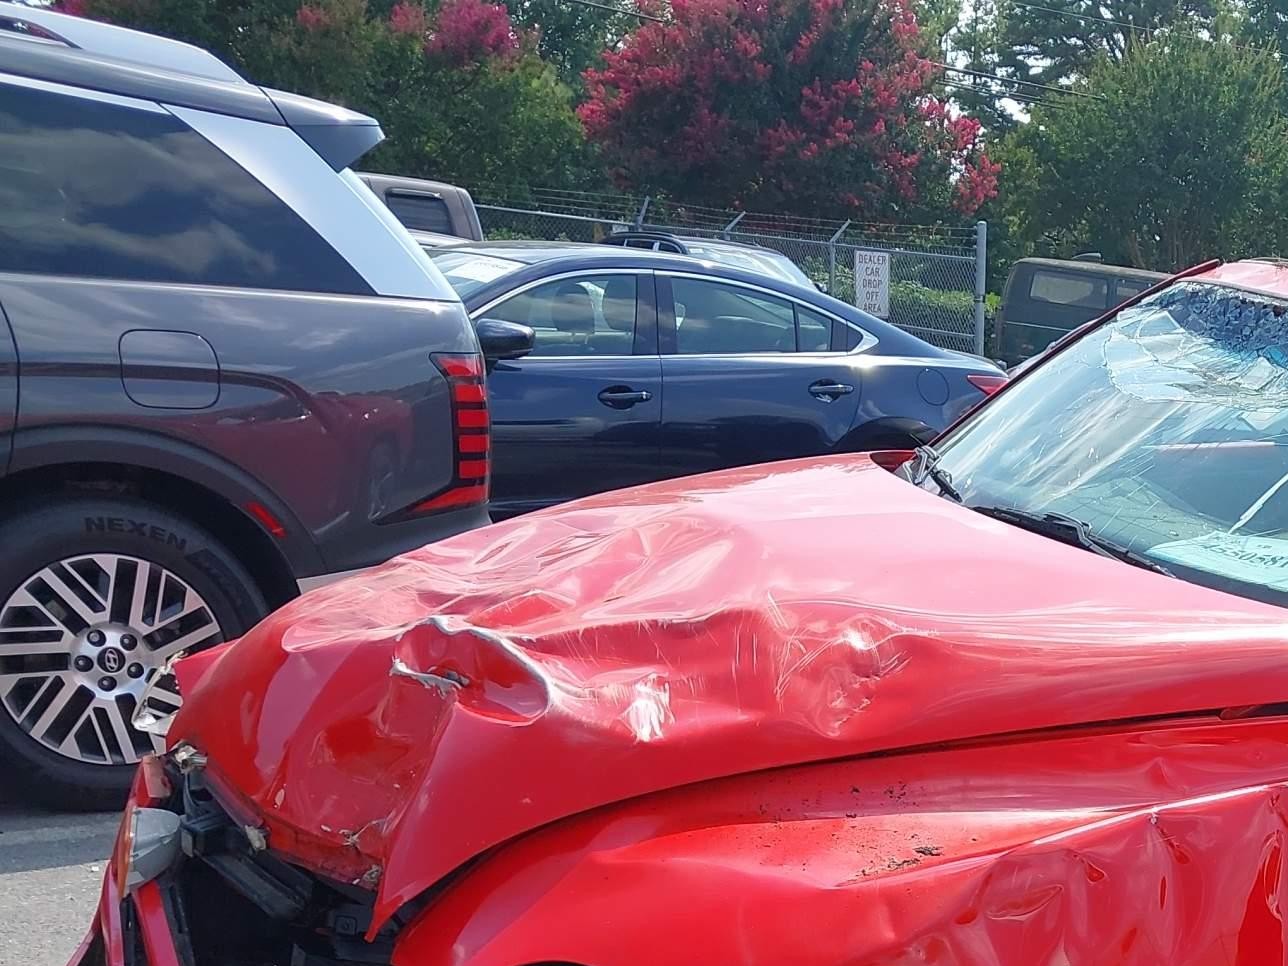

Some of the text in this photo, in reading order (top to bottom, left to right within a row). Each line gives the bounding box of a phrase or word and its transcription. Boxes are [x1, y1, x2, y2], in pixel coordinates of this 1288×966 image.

[858, 254, 887, 265] DEALER
[865, 266, 880, 277] CAR
[862, 278, 882, 289] DROP
[865, 290, 880, 301] OFF
[863, 302, 882, 313] AREA
[84, 516, 188, 550] NEXEN
